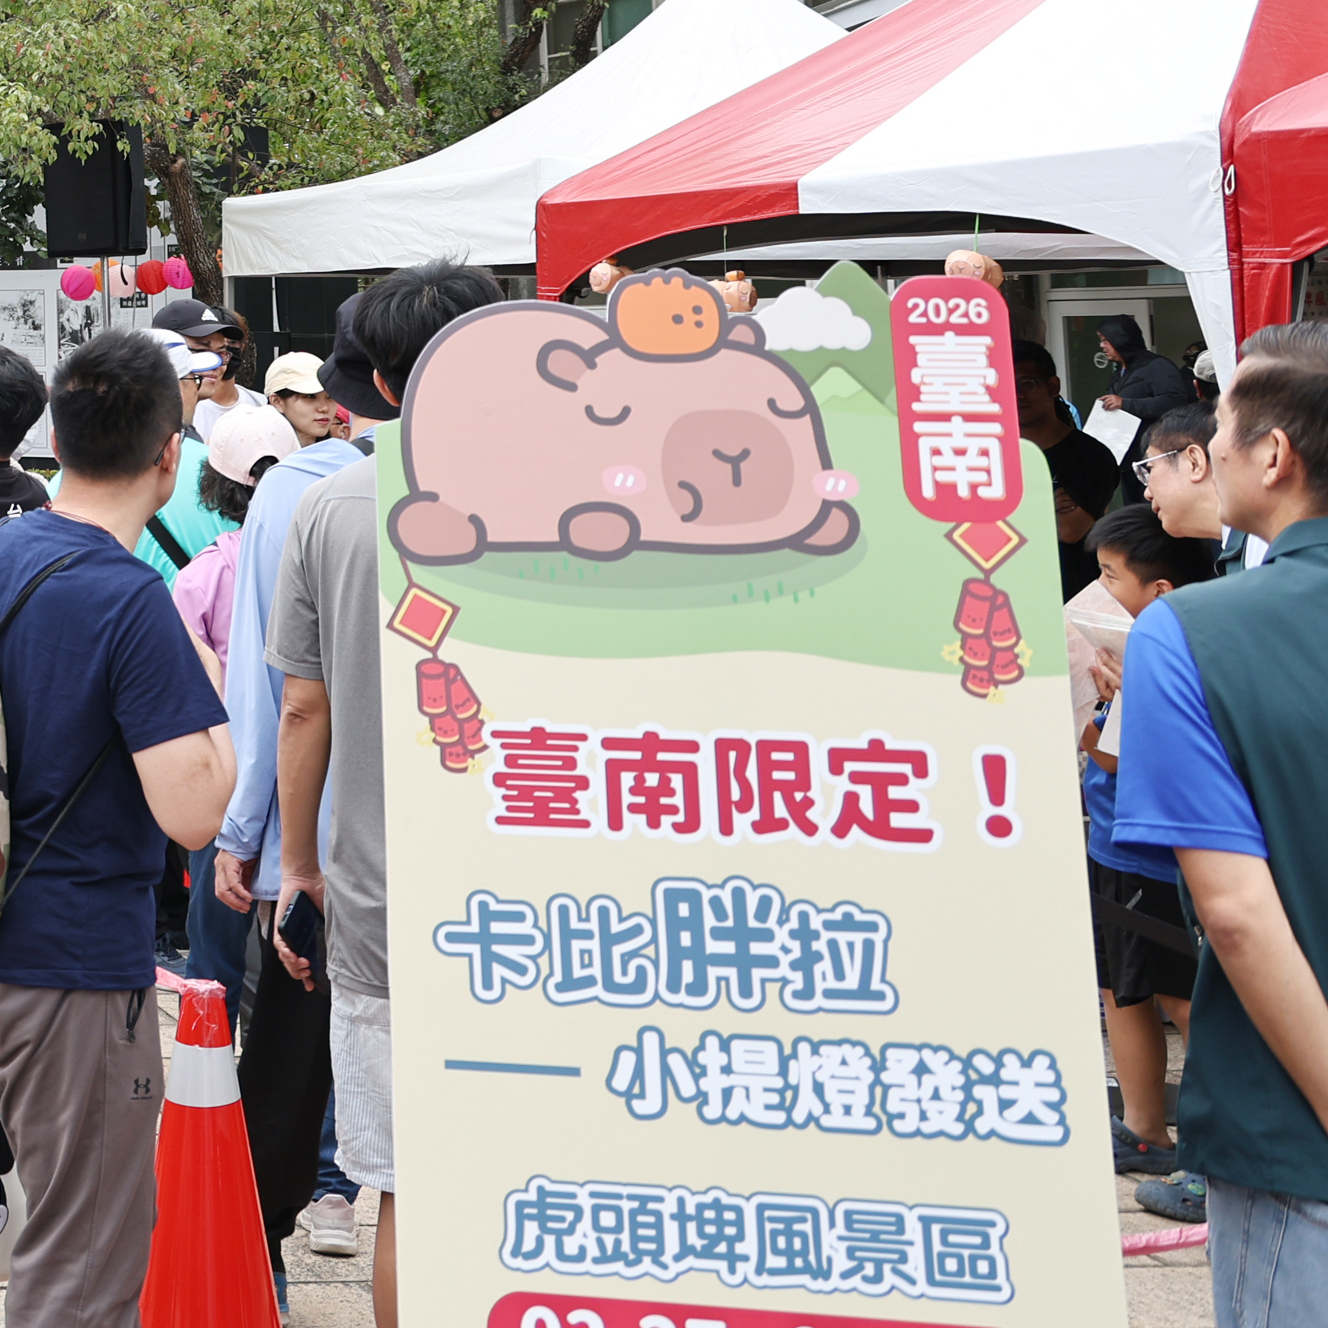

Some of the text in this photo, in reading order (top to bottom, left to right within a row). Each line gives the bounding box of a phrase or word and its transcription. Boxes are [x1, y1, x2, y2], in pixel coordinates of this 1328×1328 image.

[907, 297, 990, 325] 2026
[907, 330, 1007, 501] 臺南
[437, 880, 896, 1012] 卡比胖拉
[607, 1026, 1070, 1146] 小提燈發送
[502, 1180, 1012, 1299] 虎頭埤風景區
